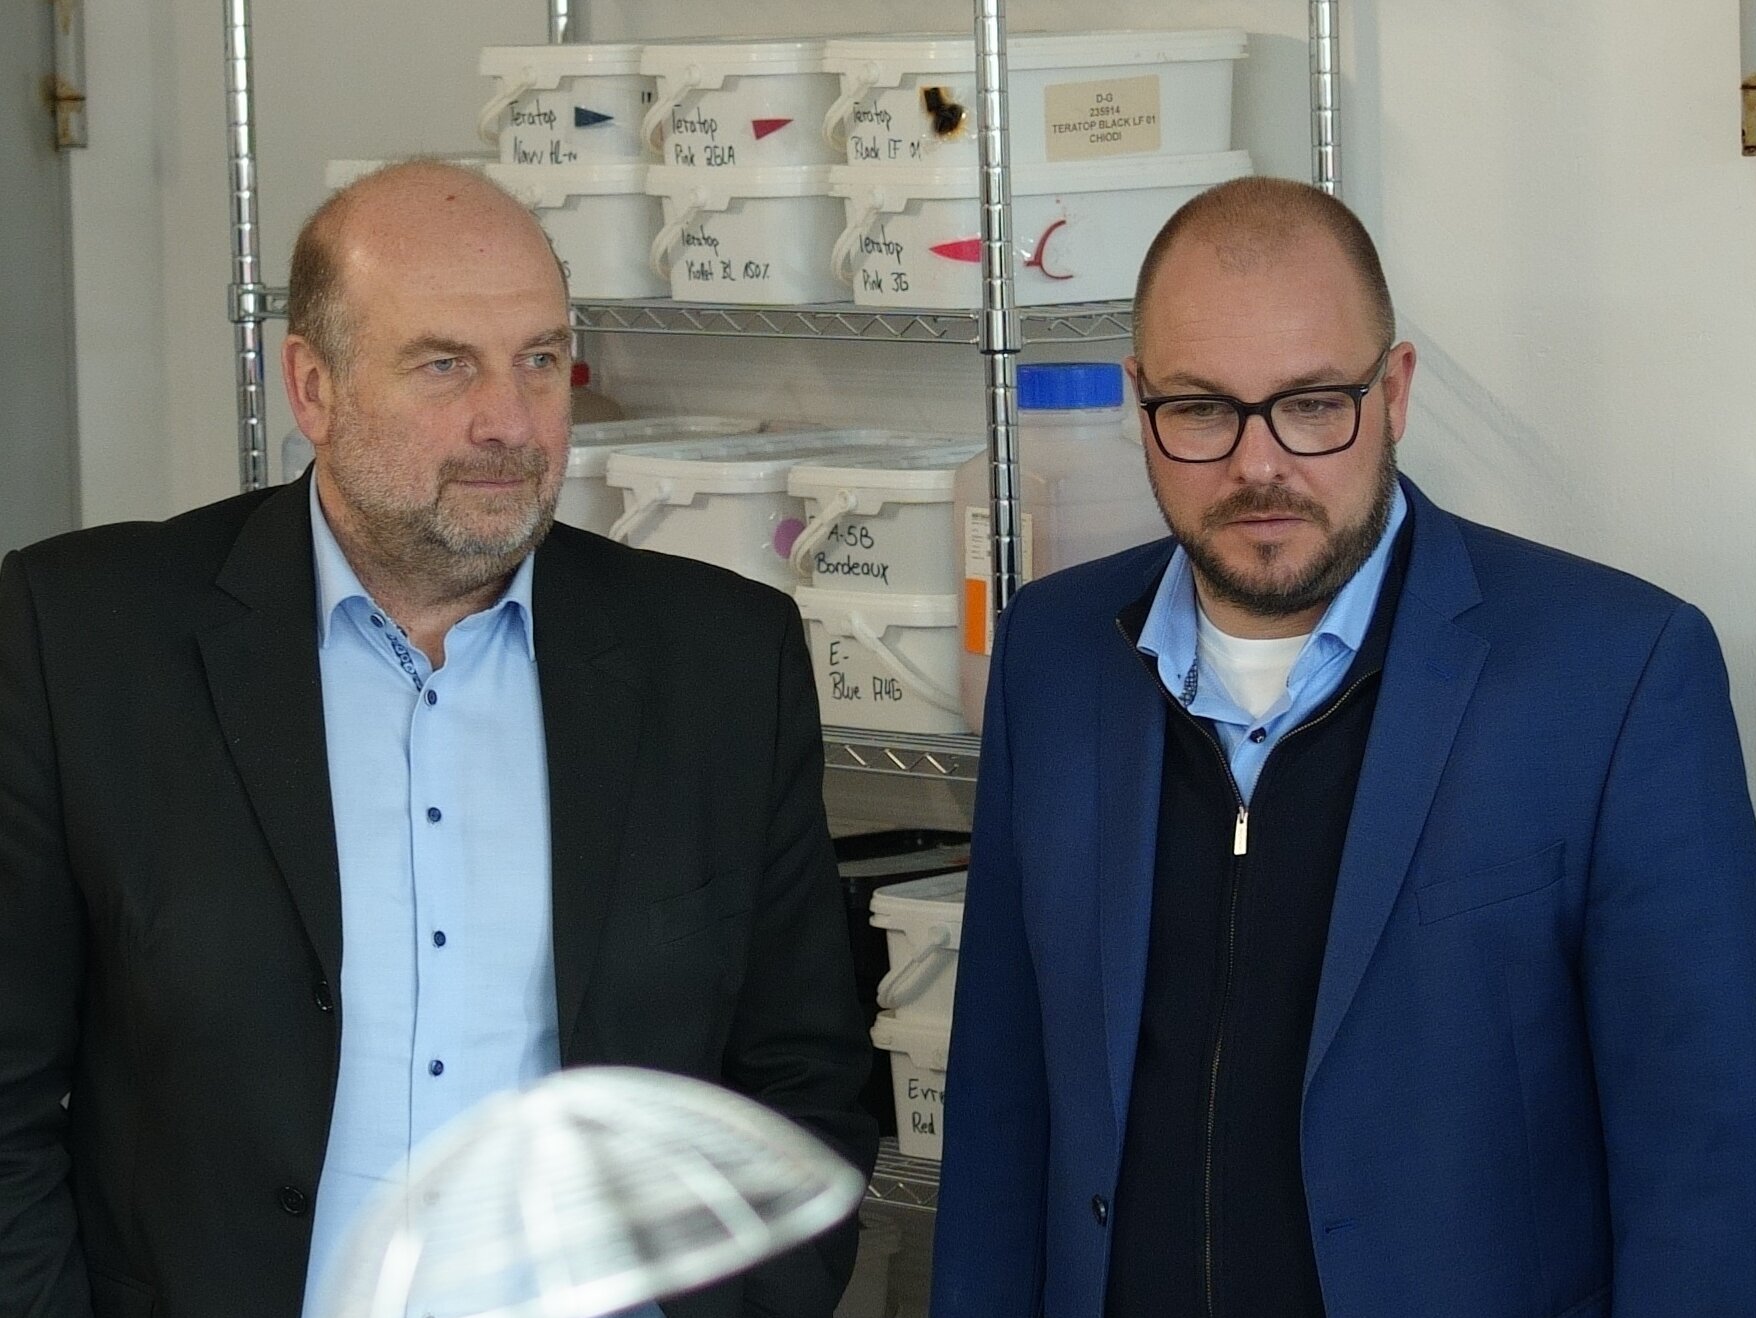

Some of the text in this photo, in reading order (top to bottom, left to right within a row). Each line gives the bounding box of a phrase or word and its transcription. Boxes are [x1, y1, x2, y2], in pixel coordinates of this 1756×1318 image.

[508, 100, 557, 130] Teratop
[671, 104, 718, 141] Teratop
[852, 100, 893, 132] Teratop
[1052, 115, 1156, 134] TERATOP BLACK LF 01
[862, 268, 883, 293] Pink
[814, 551, 889, 586] Bordeaux
[829, 671, 861, 700] Blue
[912, 1111, 936, 1135] Red
